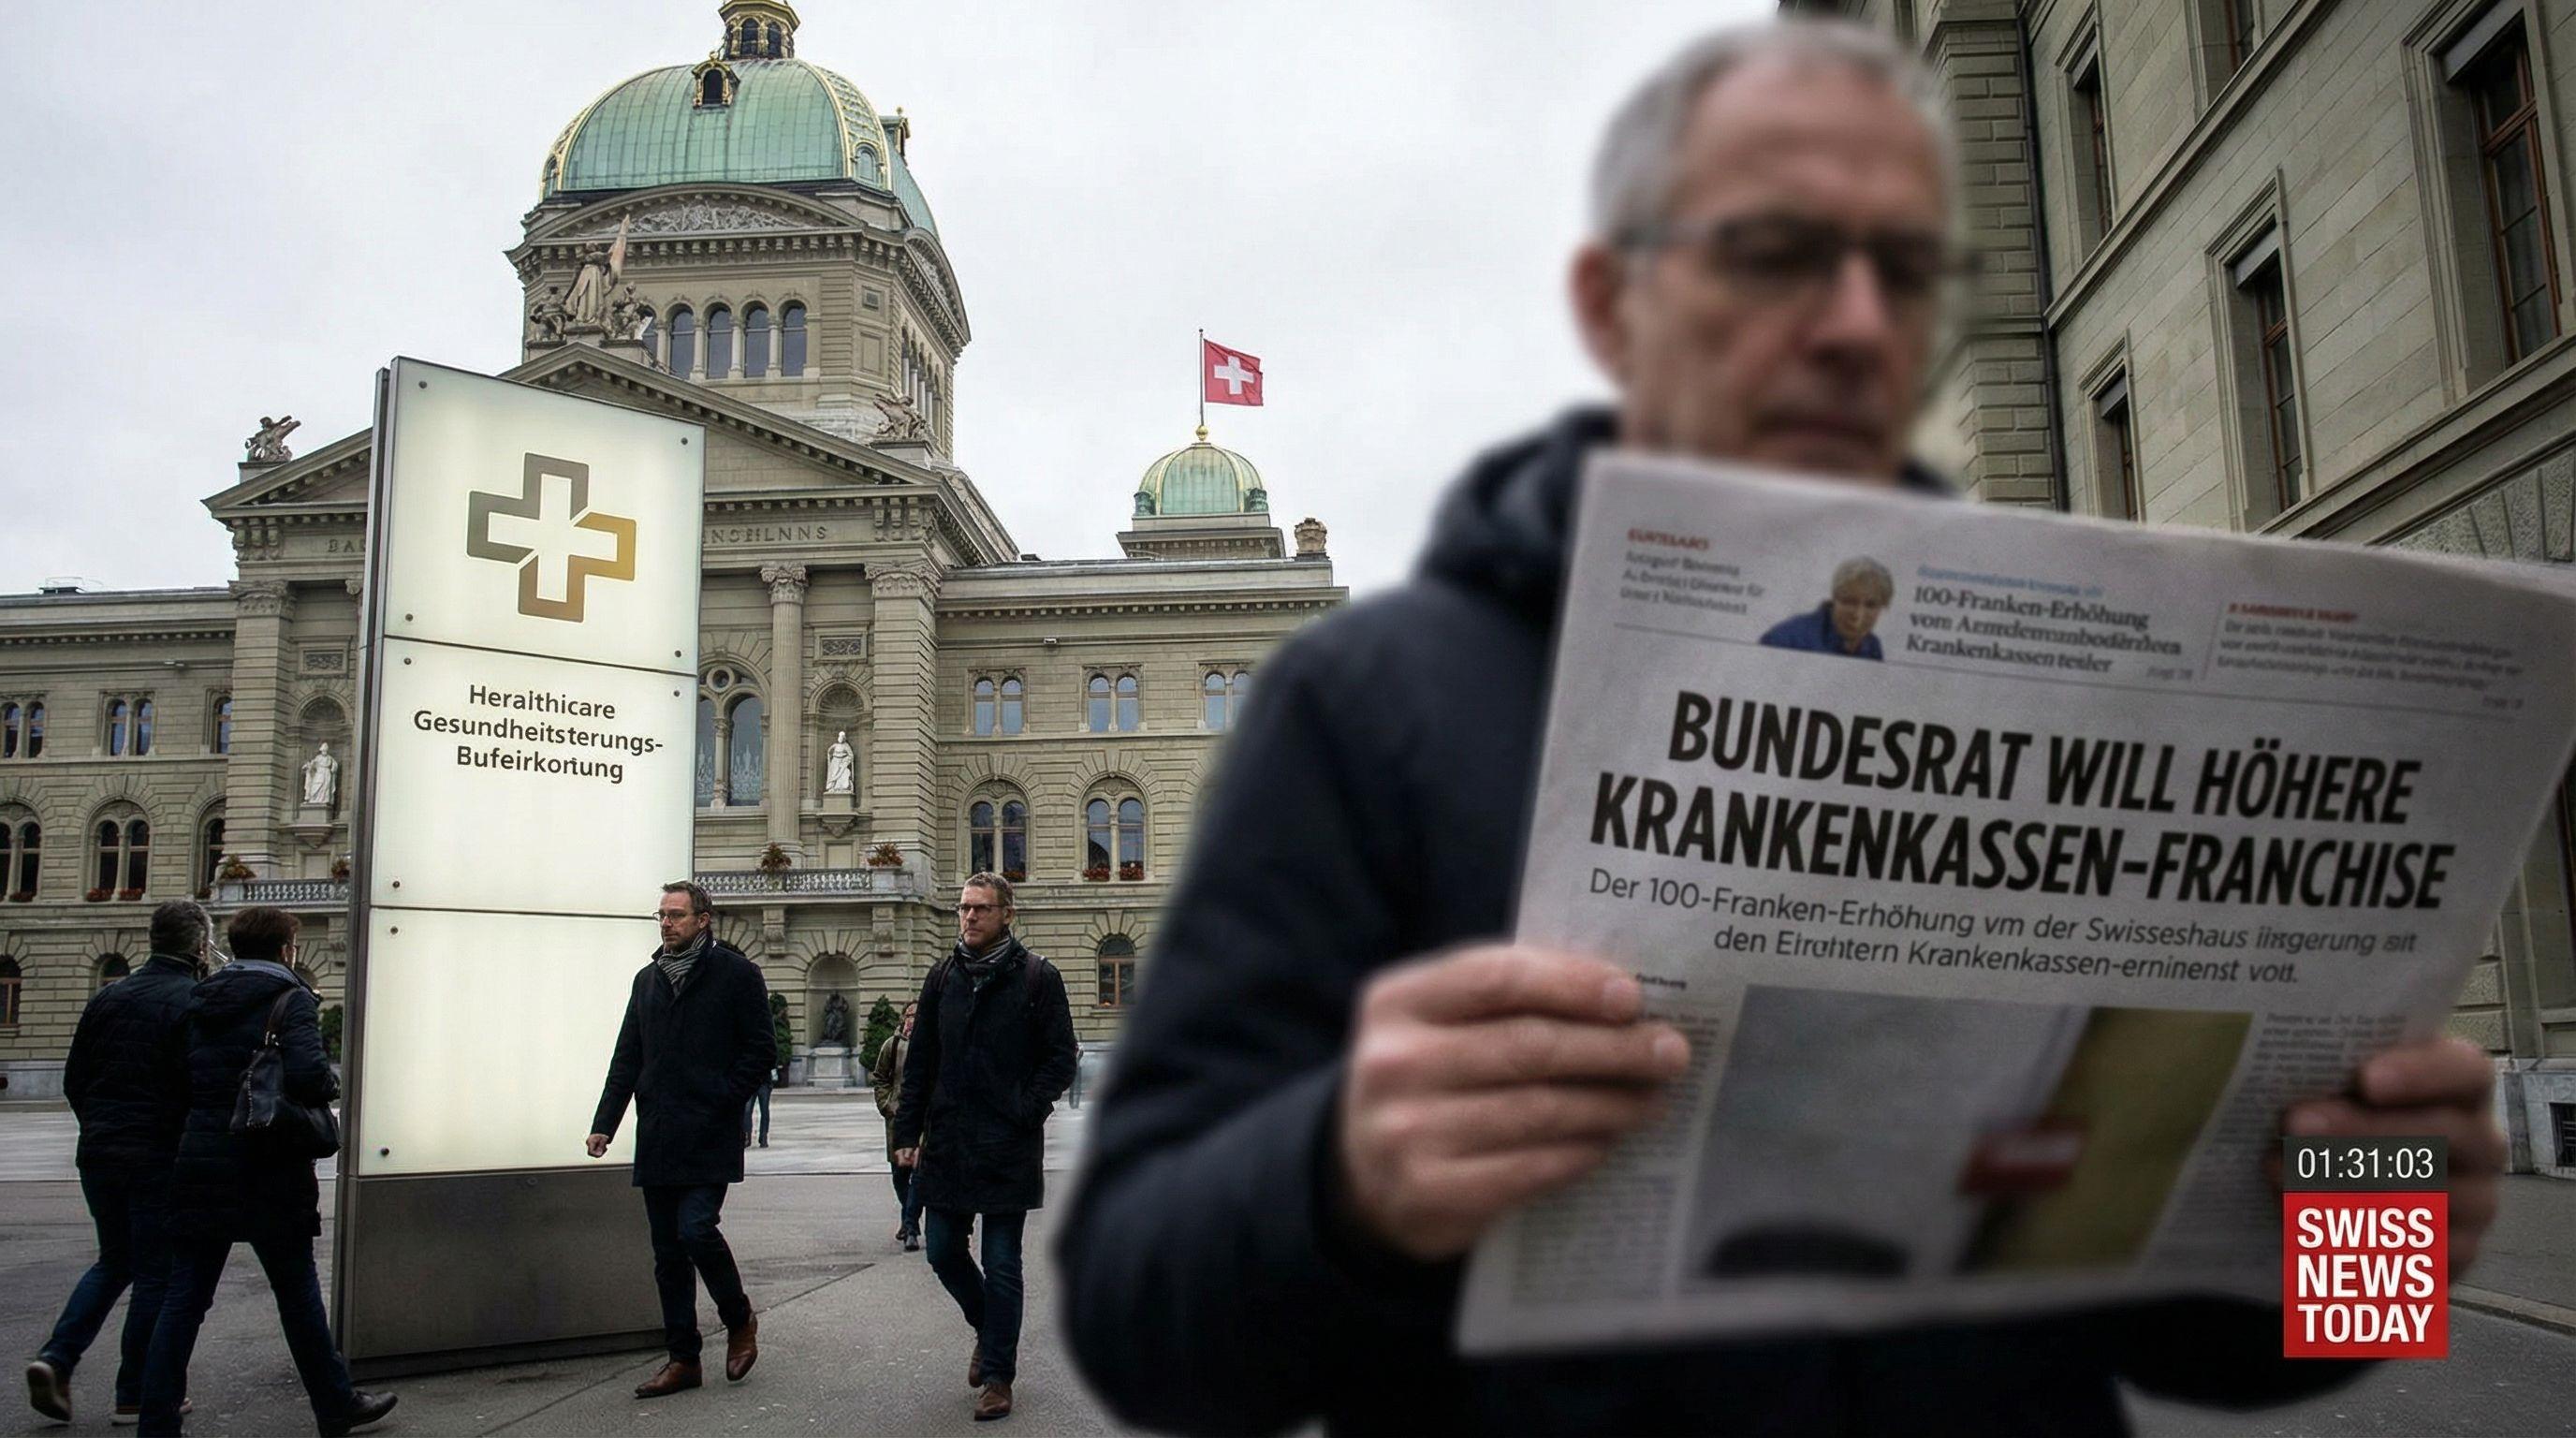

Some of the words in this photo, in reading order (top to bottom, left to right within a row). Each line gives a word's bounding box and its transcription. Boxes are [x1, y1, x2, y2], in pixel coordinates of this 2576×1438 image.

[414, 710, 663, 756] Gesundheitsterungs-
[1668, 691, 2033, 802] BUNDESRAT
[2047, 735, 2177, 813] WILL
[2192, 739, 2422, 826] HÖHERE
[1589, 772, 2455, 910] KRANKENKASSEN-FRANCHISE
[1590, 868, 1641, 900] Der
[1649, 877, 1976, 938] 100-Franken-Erhöhung
[1984, 917, 2024, 937] vm
[2033, 914, 2079, 940] der
[2086, 916, 2248, 949] Swisseshaus
[1715, 925, 1766, 954] den
